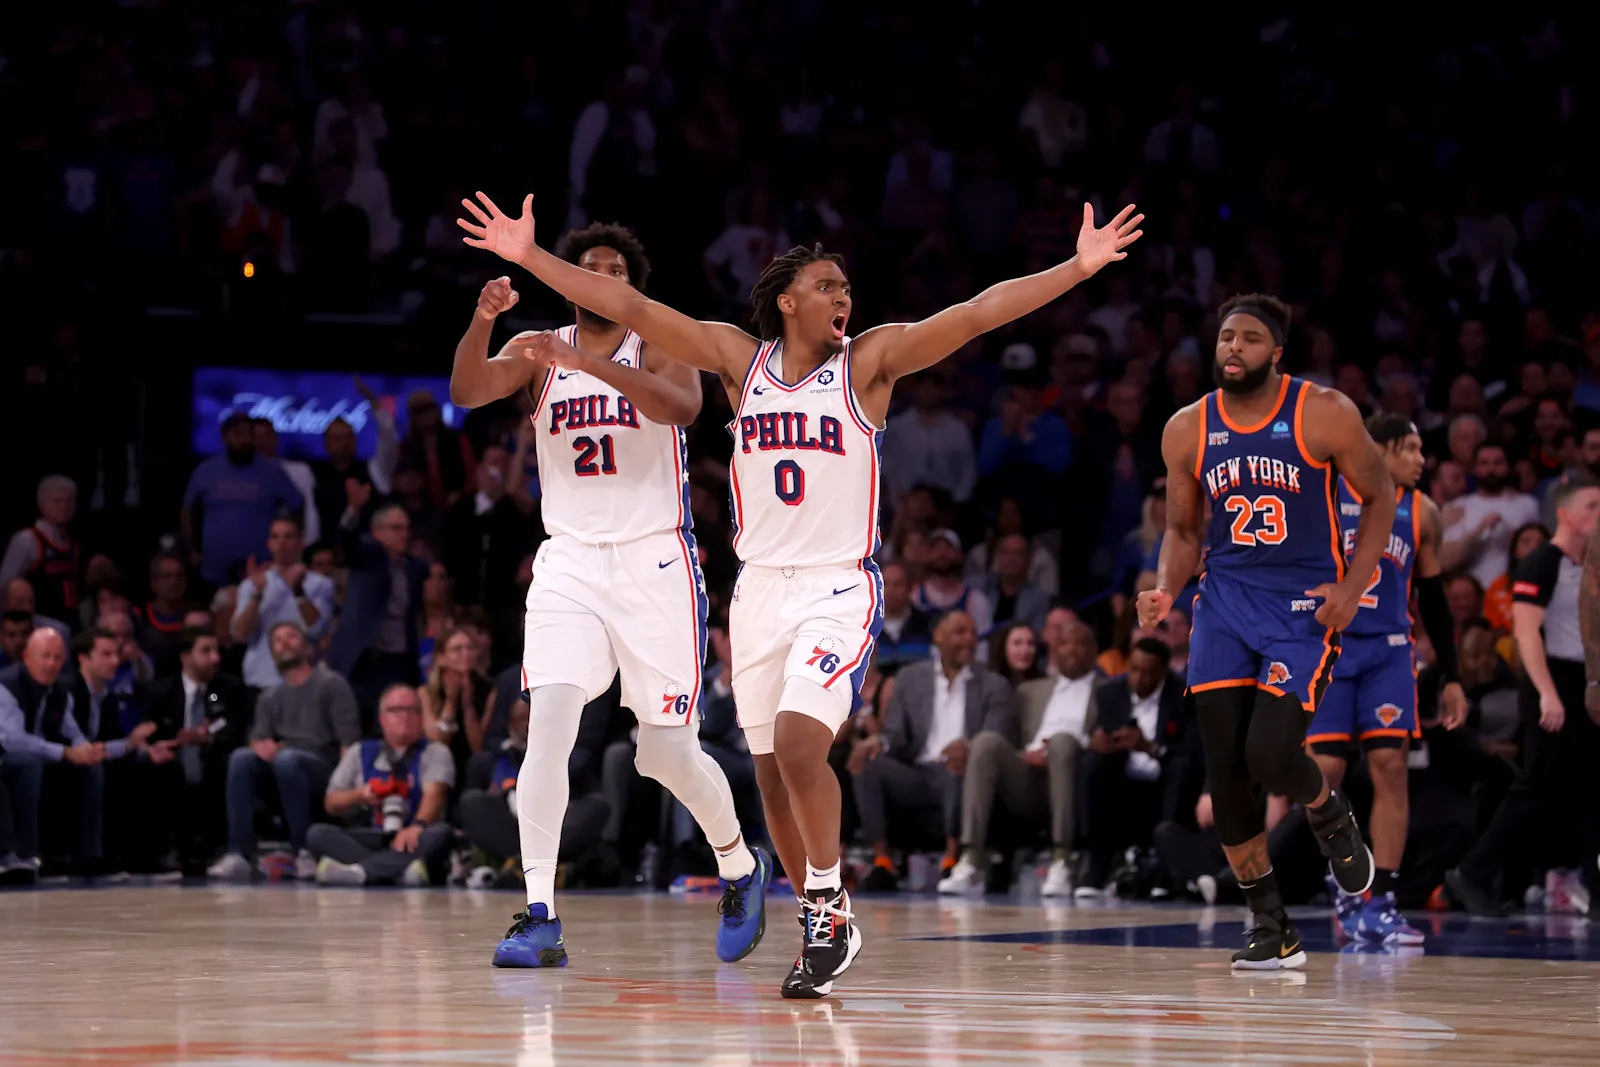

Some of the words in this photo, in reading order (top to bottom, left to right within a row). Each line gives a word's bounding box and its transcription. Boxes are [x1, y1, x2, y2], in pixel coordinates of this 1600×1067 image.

[810, 387, 842, 395] crypto.com
[550, 395, 640, 435] PHILA
[740, 412, 846, 456] PHILA
[572, 434, 617, 477] 21
[1208, 431, 1230, 445] NYC
[774, 459, 805, 506] 0
[1205, 456, 1241, 499] NEW
[1246, 455, 1301, 493] YORK
[1224, 495, 1288, 547] 23
[1291, 599, 1316, 611] NYC
[805, 645, 841, 674] 76
[661, 692, 689, 715] 76
